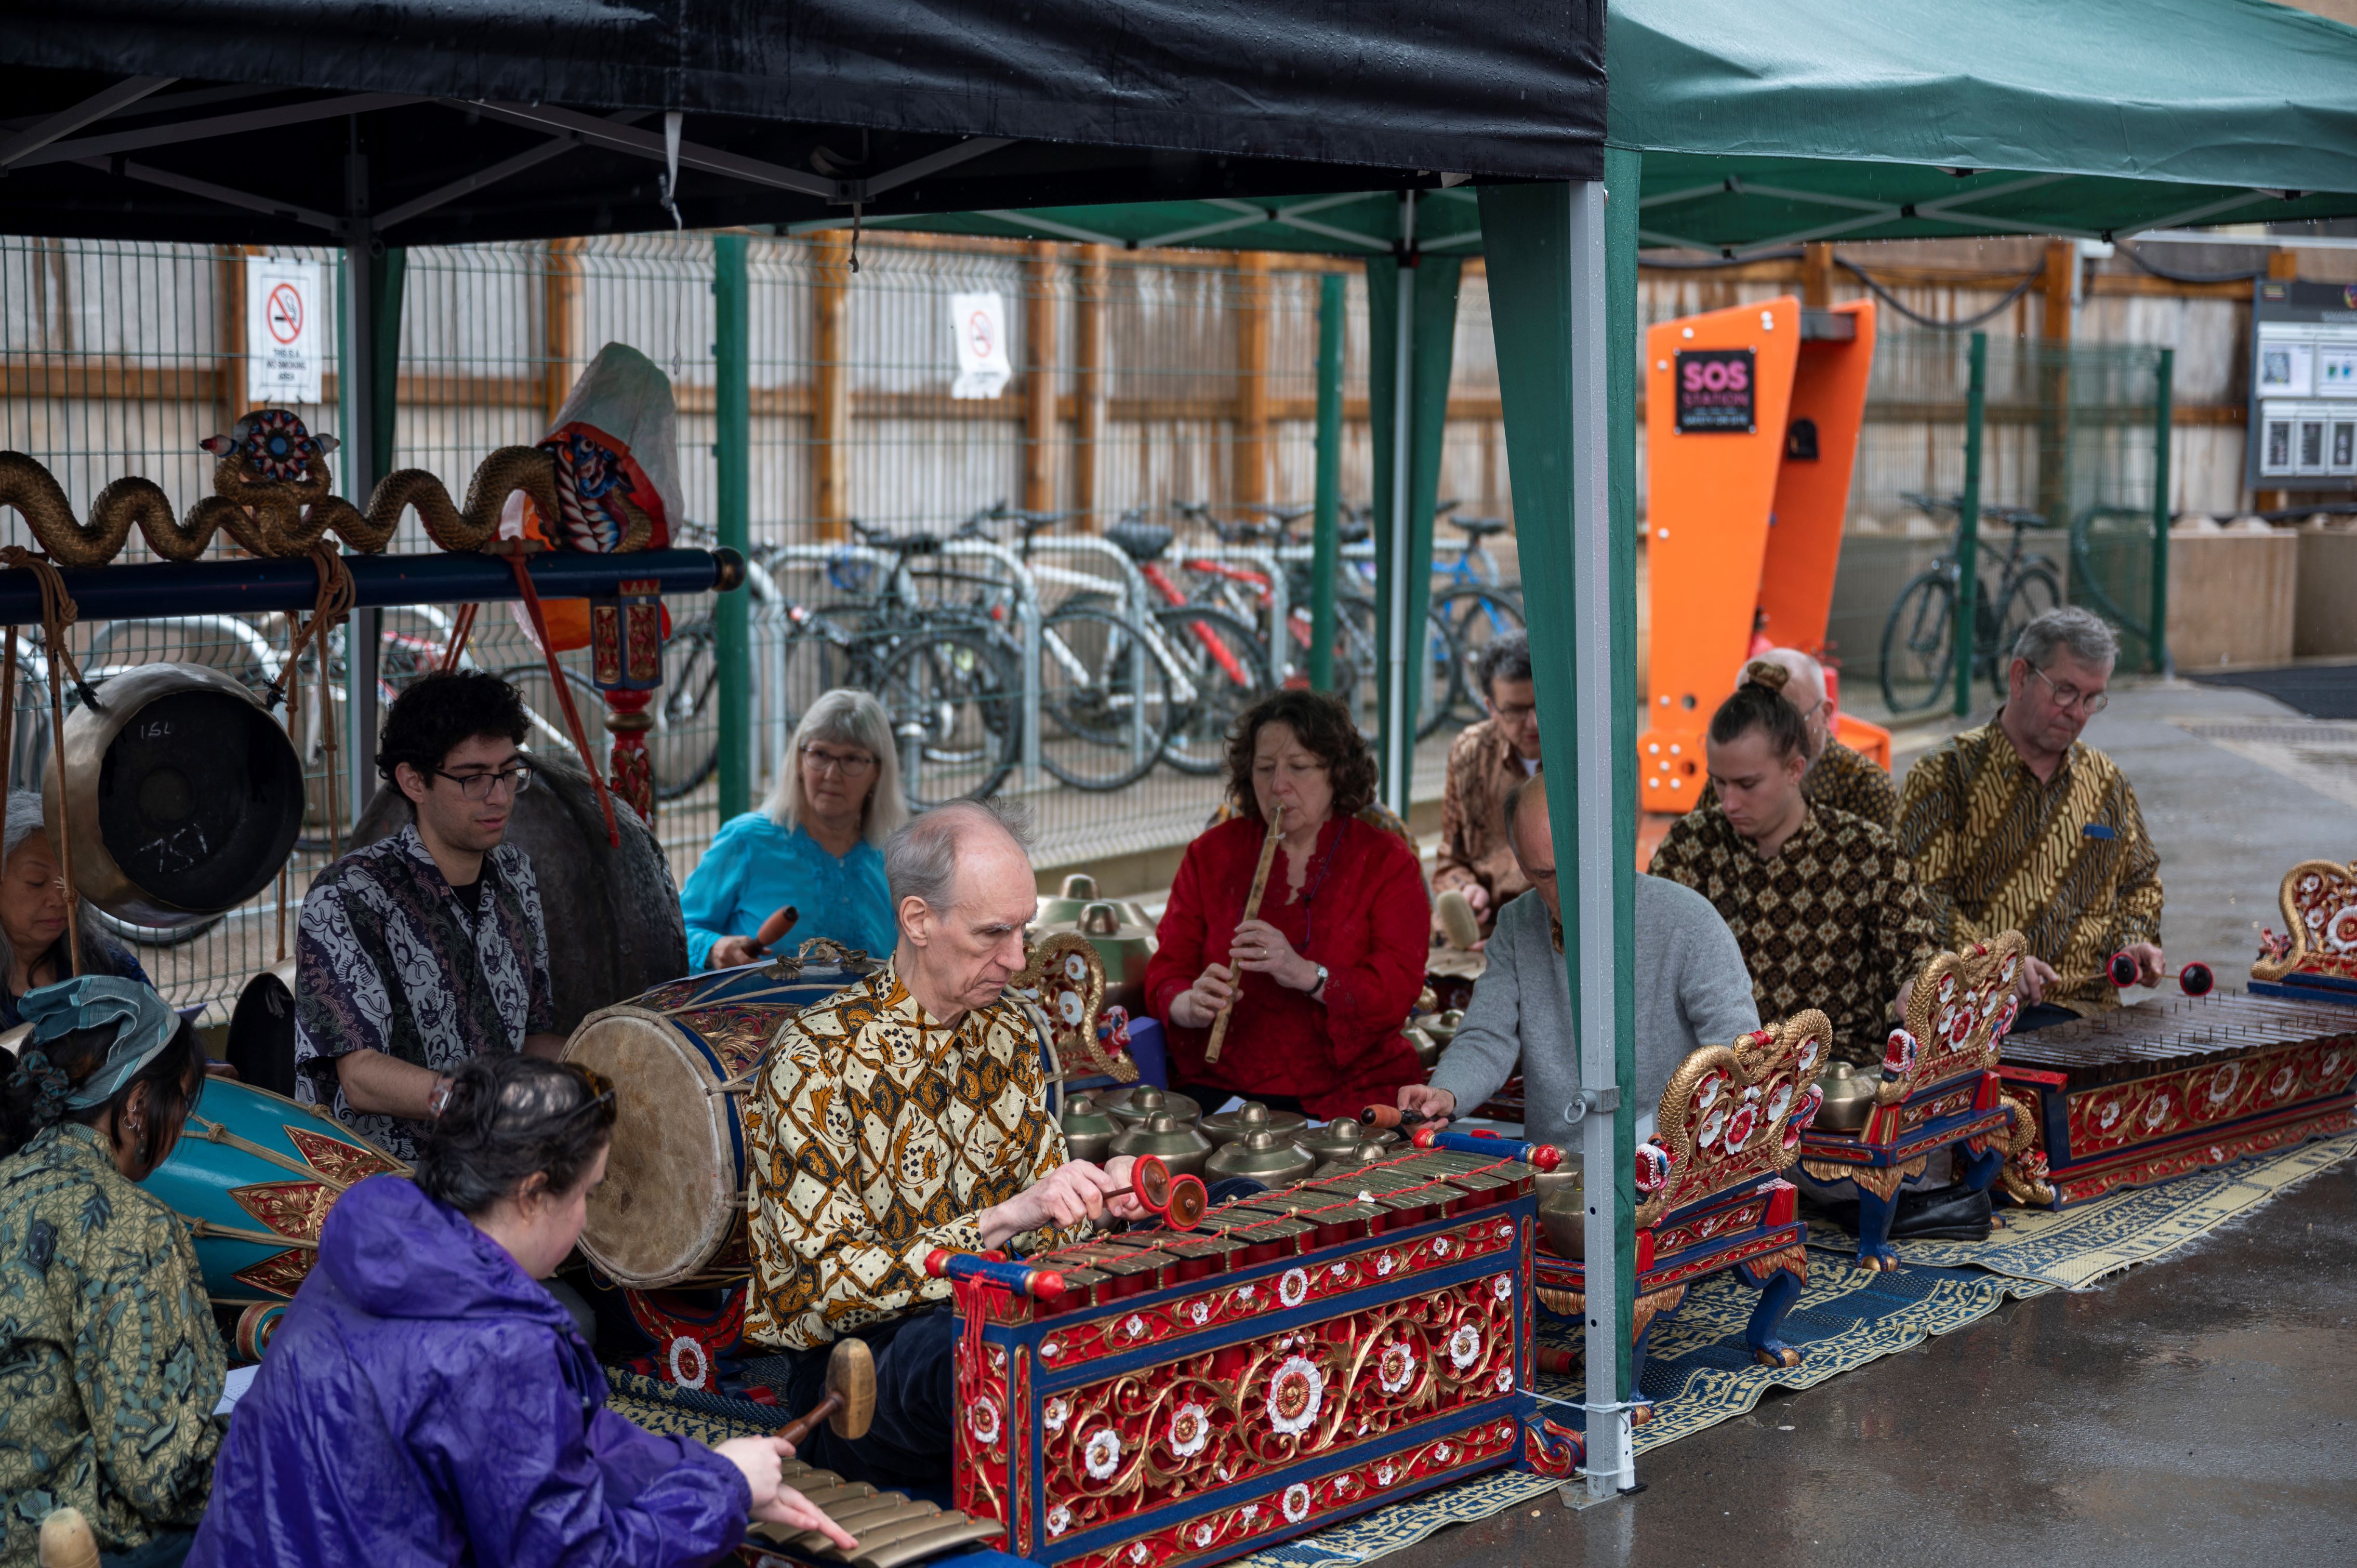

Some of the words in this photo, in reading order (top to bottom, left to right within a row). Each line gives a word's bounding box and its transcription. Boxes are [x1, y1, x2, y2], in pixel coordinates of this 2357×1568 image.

[273, 348, 287, 358] THIS
[296, 349, 301, 357] A
[267, 360, 276, 369] NO
[278, 361, 307, 370] SMOKING
[279, 373, 296, 381] AREA
[1684, 361, 1748, 392] SOS
[1683, 393, 1749, 407] STATION
